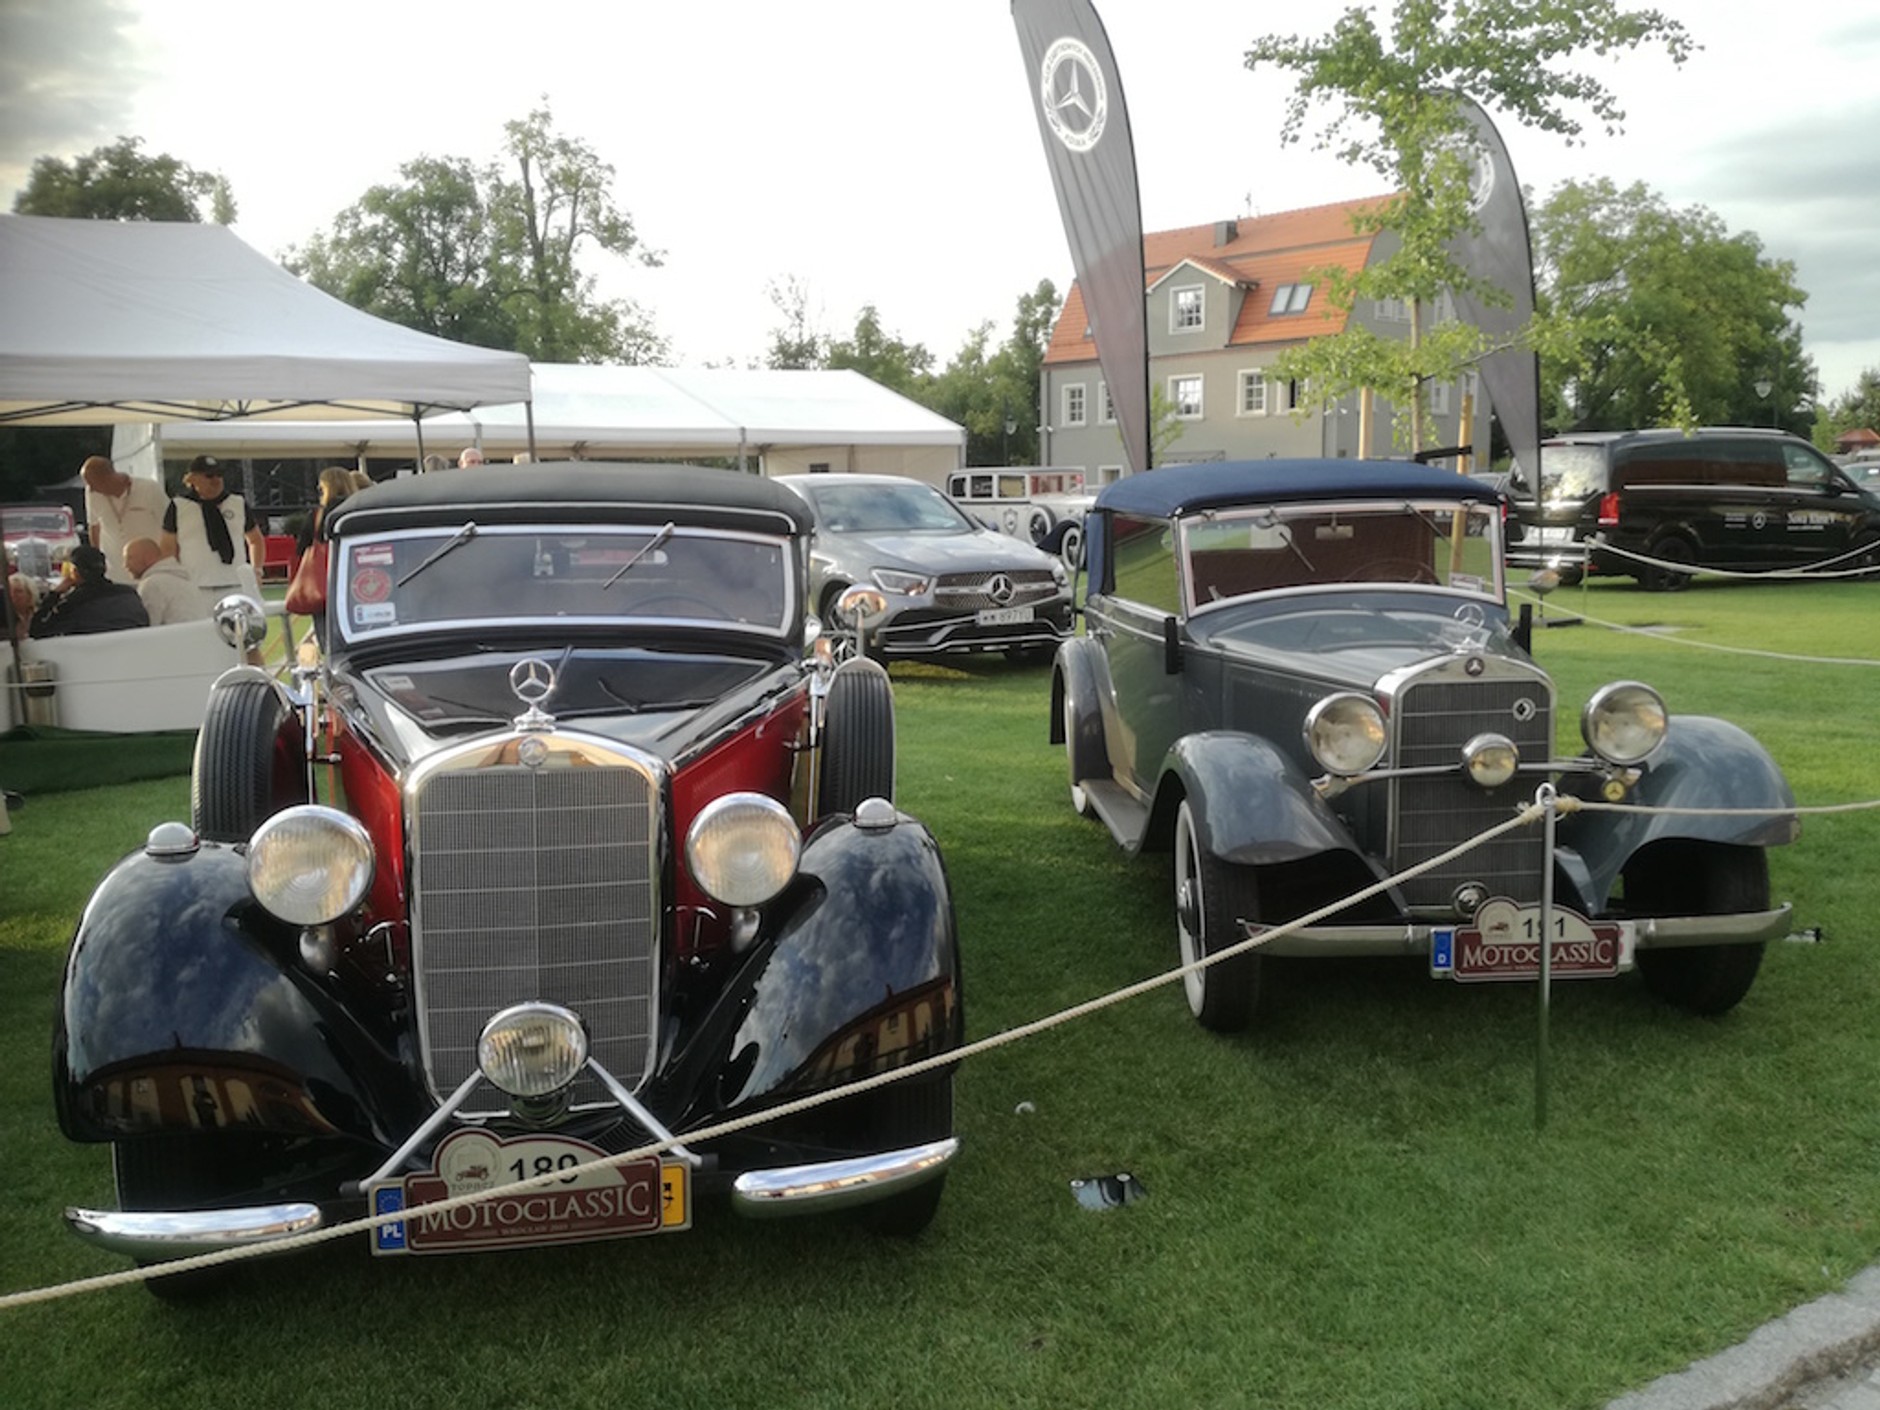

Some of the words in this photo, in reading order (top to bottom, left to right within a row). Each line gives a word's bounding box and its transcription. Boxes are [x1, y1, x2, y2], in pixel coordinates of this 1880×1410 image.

[1522, 916, 1565, 939] 11
[1437, 953, 1447, 964] D
[1463, 940, 1612, 968] MOTOCASSIC
[419, 1181, 650, 1235] MOTOCLASSIC
[382, 1223, 403, 1239] PL
